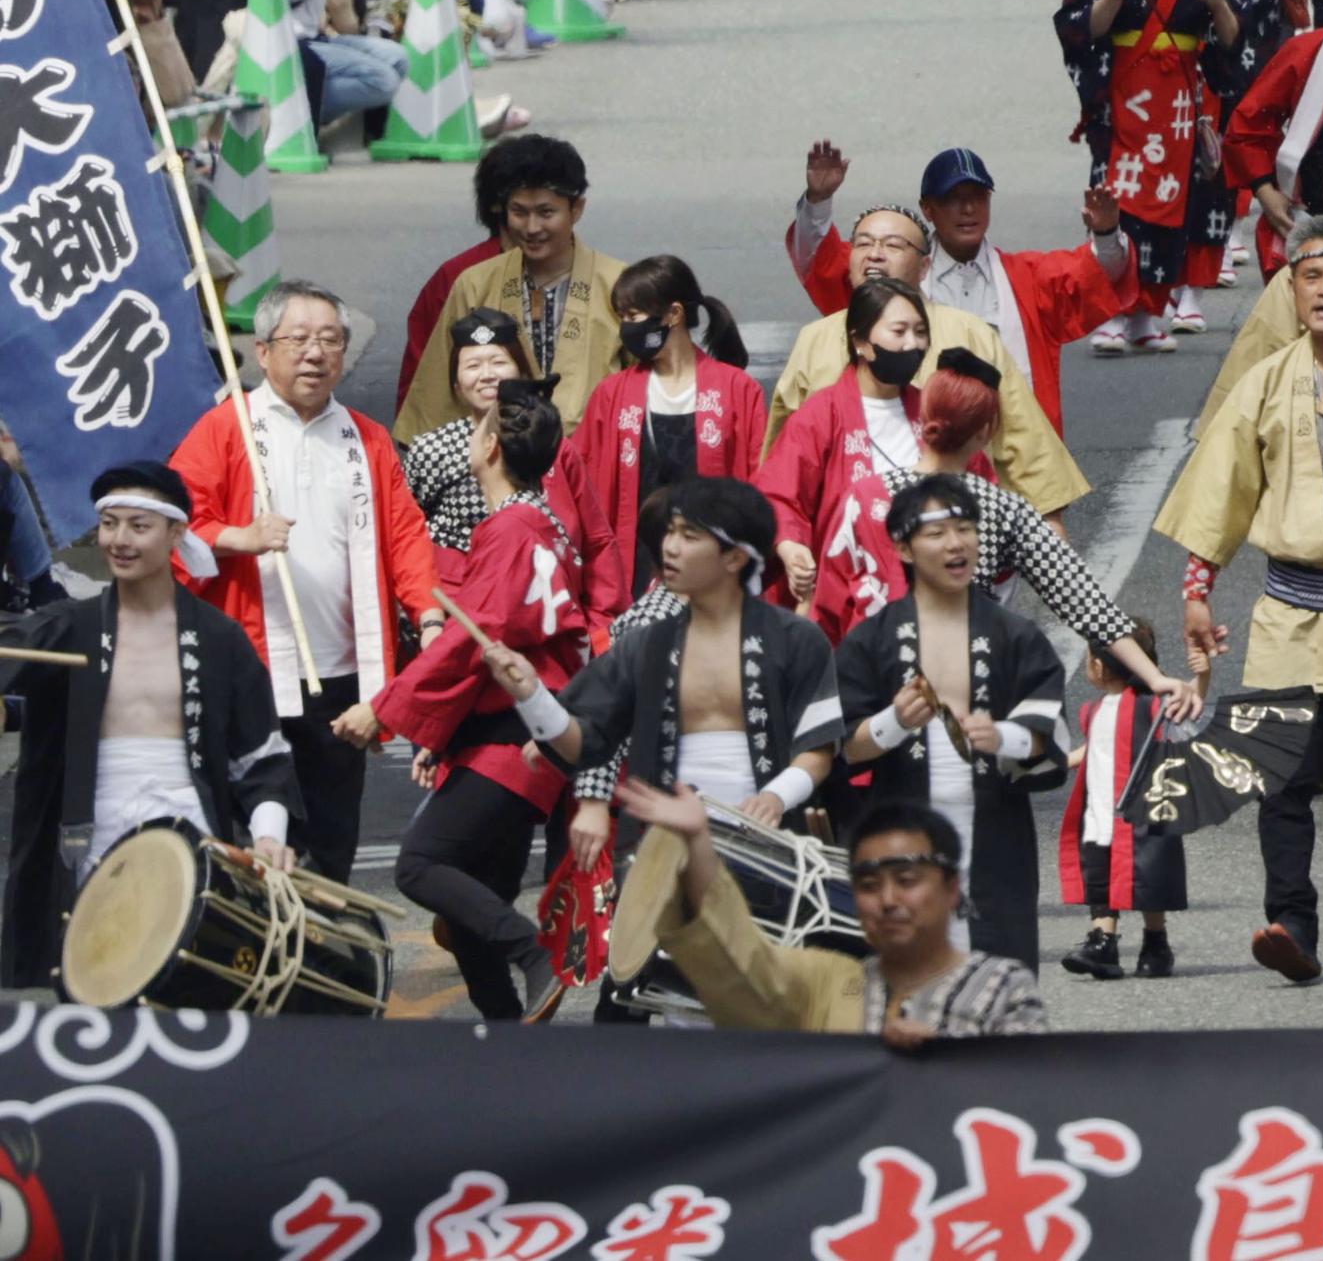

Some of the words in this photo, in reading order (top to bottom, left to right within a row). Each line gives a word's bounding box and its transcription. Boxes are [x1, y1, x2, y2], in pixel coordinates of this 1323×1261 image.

[340, 425, 369, 532] 城島まつり
